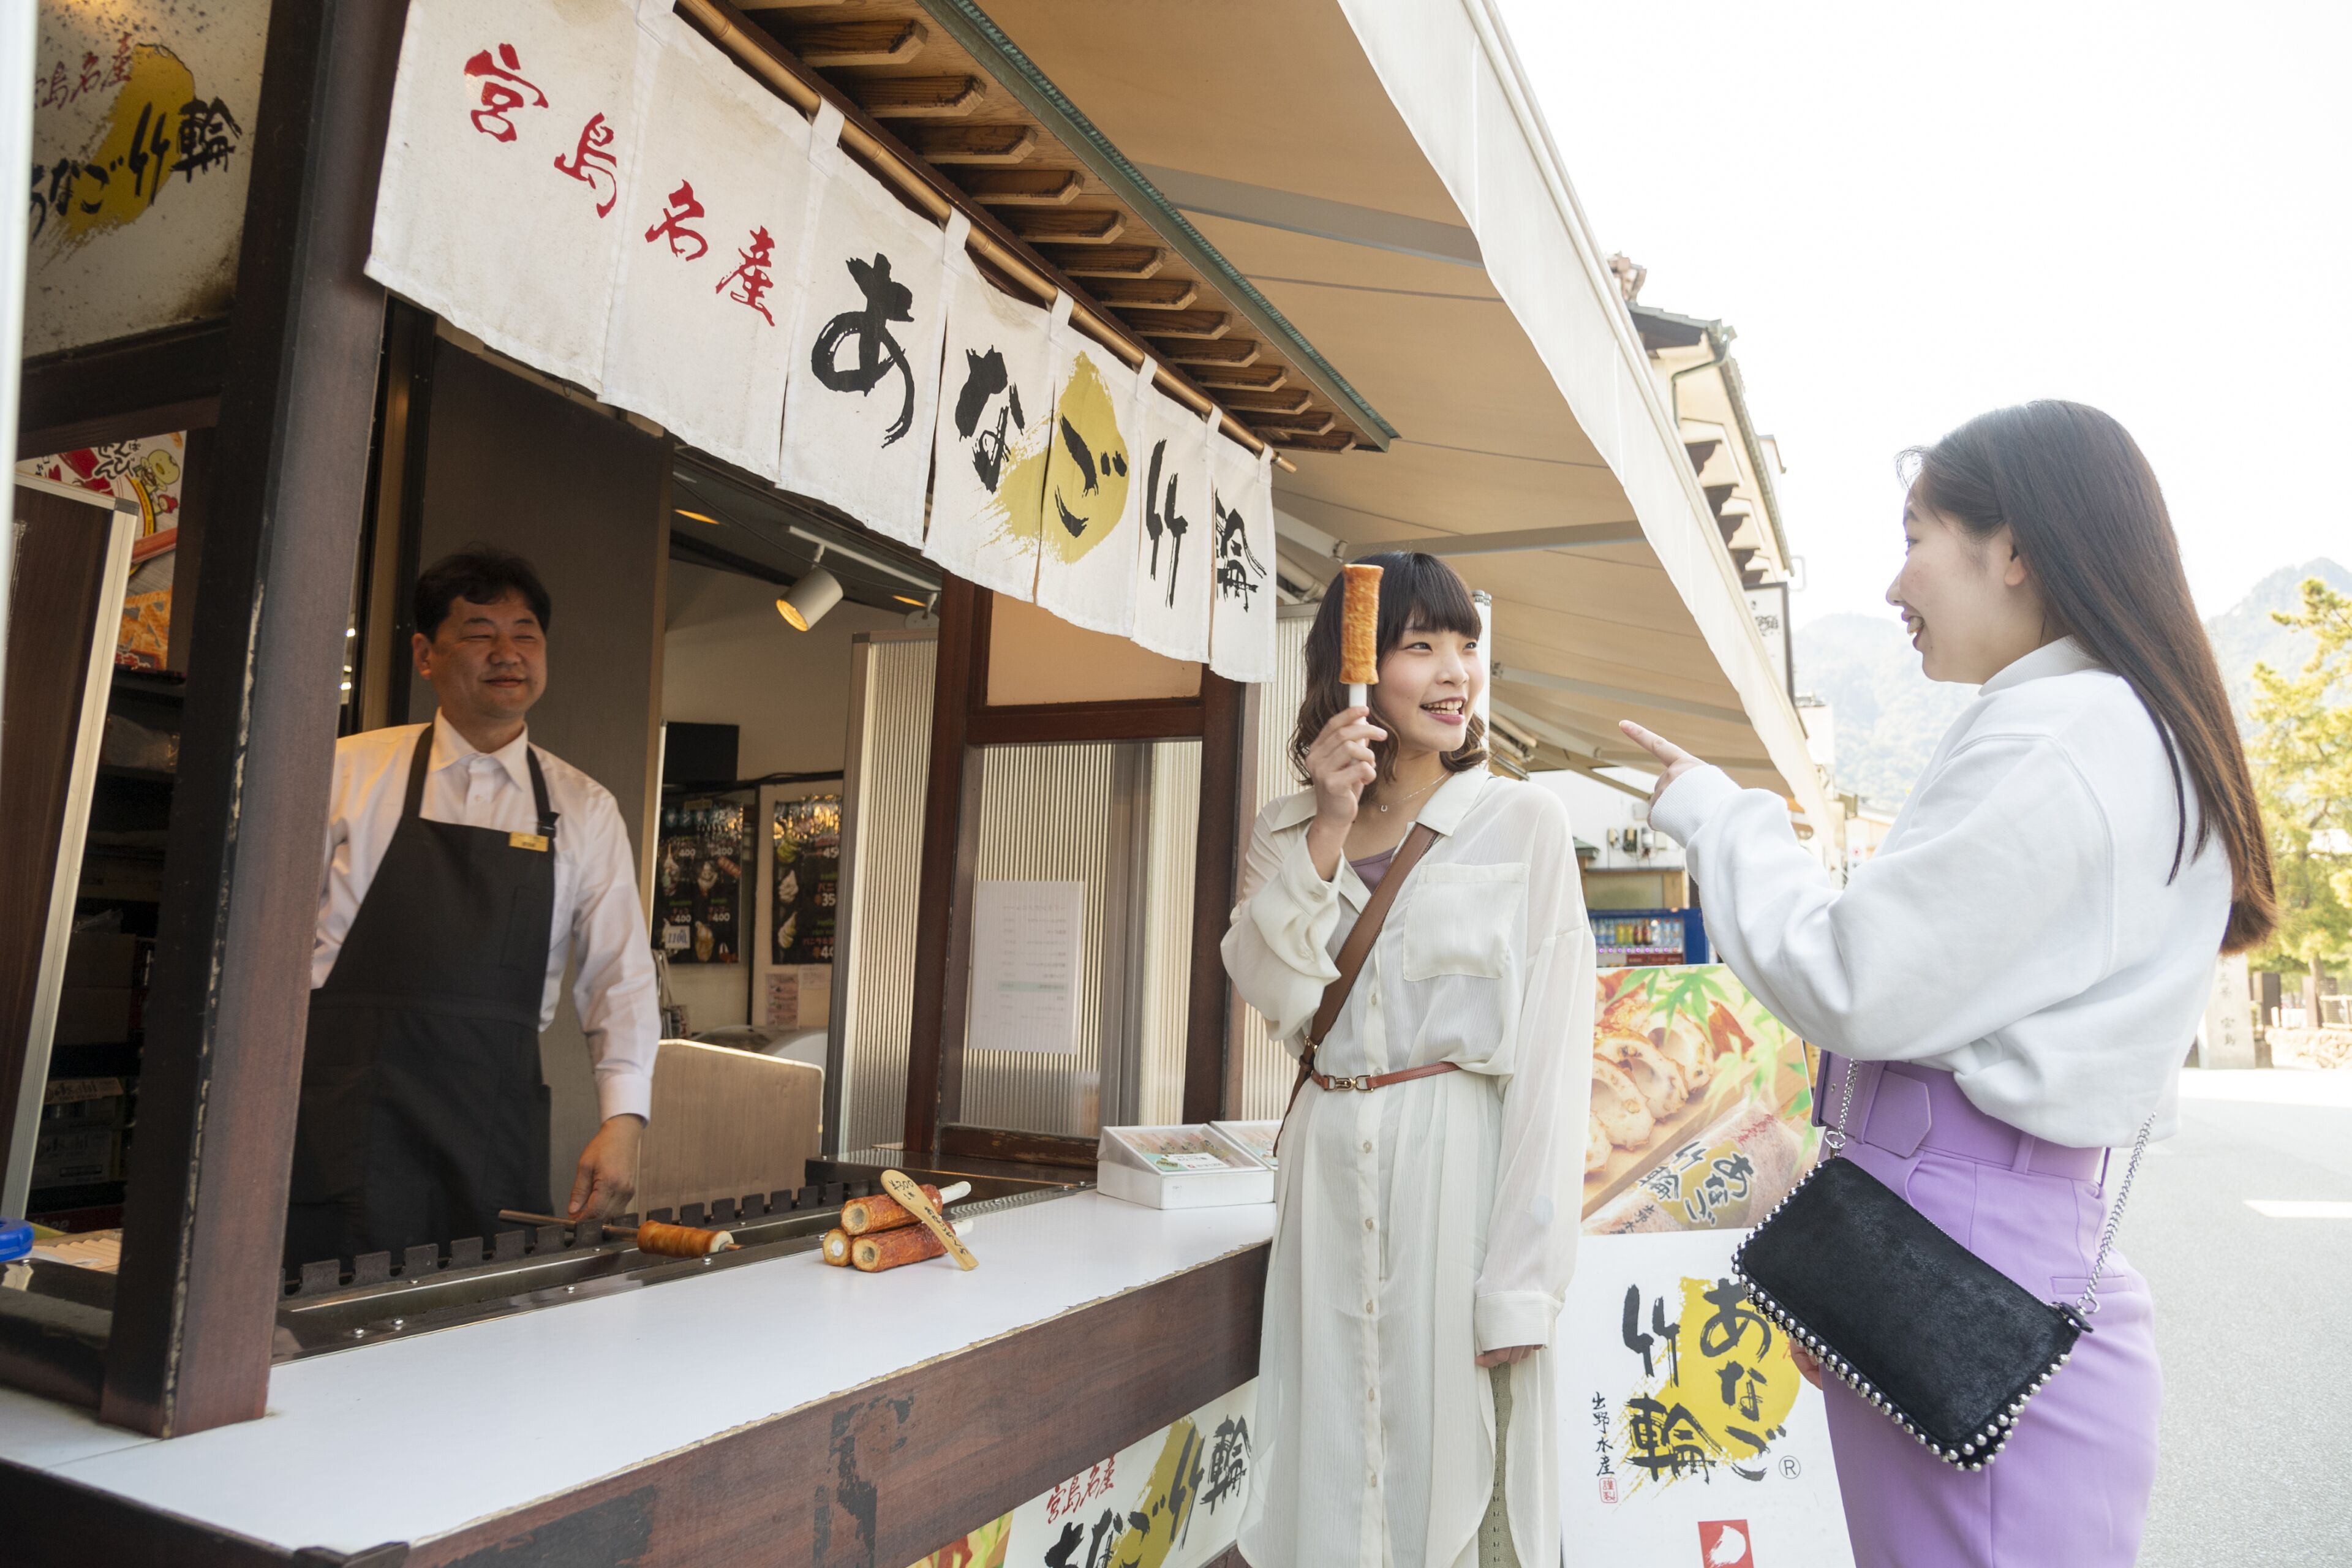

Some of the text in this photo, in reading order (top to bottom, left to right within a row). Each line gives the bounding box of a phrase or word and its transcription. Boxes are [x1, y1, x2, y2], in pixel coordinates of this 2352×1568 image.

[464, 43, 775, 327] 宮島名産
[812, 252, 1267, 613] あなご竹輪
[1685, 1153, 1754, 1225] あなご
[1592, 1391, 1616, 1477] 出野水産
[1622, 1284, 1723, 1484] 竹輪
[1700, 1278, 1786, 1481] あなご
